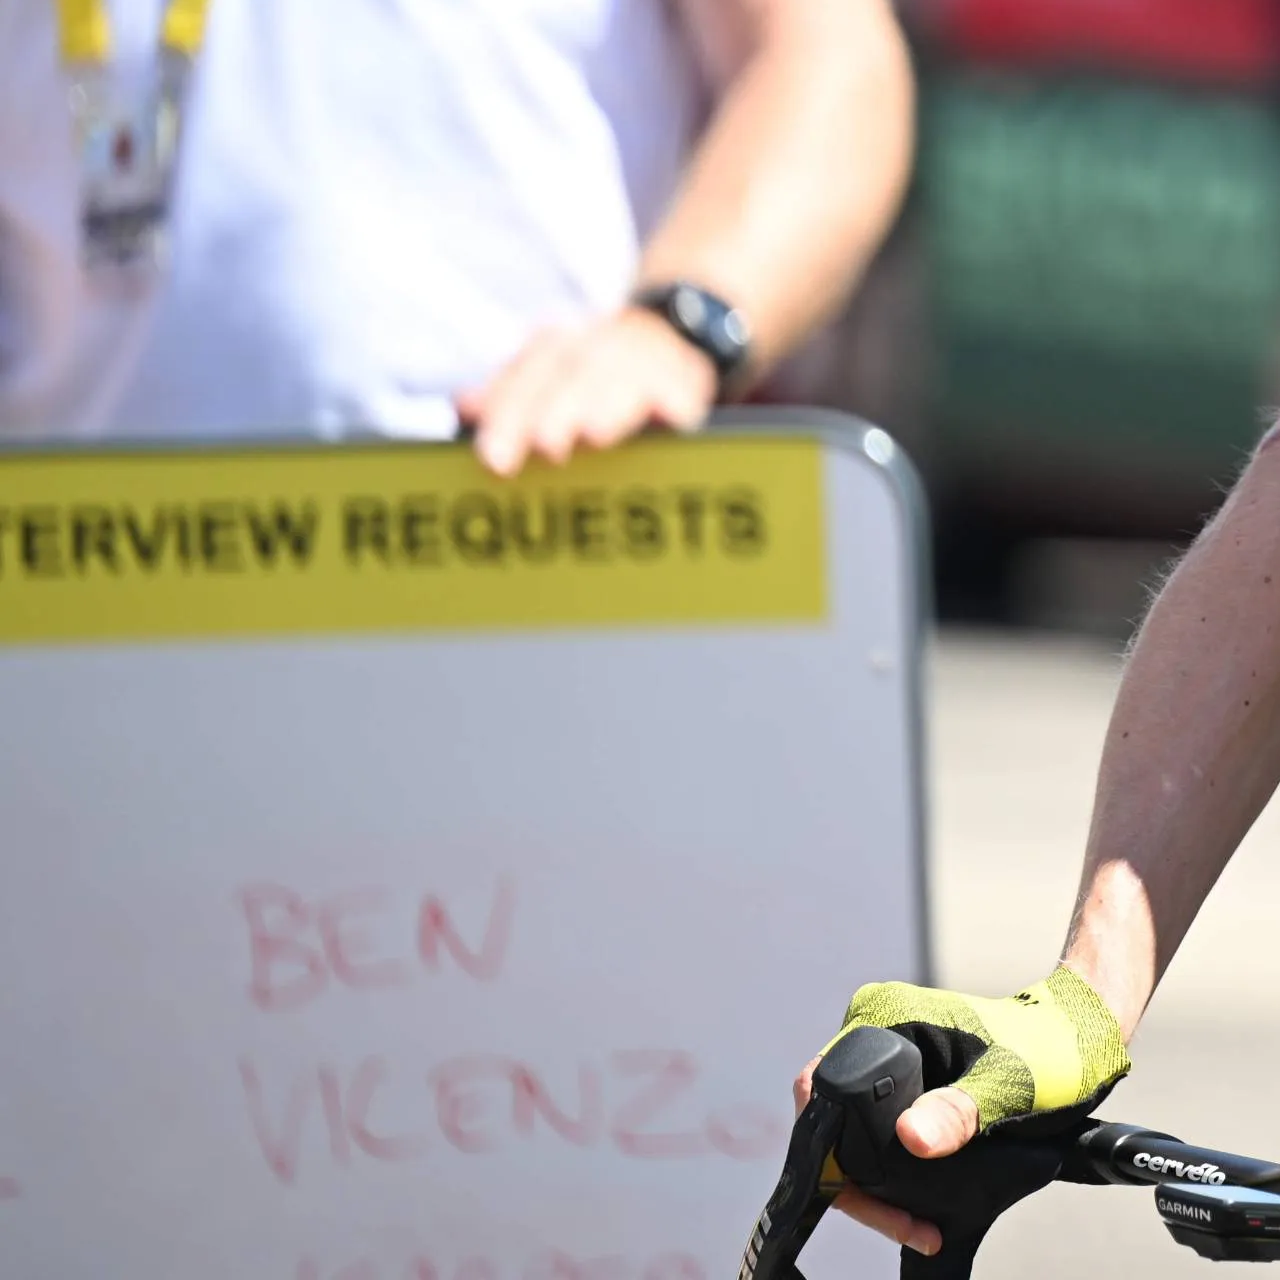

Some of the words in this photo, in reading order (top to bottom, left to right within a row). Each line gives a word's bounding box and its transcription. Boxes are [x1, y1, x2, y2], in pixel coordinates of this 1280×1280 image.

[339, 485, 771, 570] REQUESTS
[237, 878, 518, 1013] BEN
[1158, 1197, 1212, 1223] GARMIN
